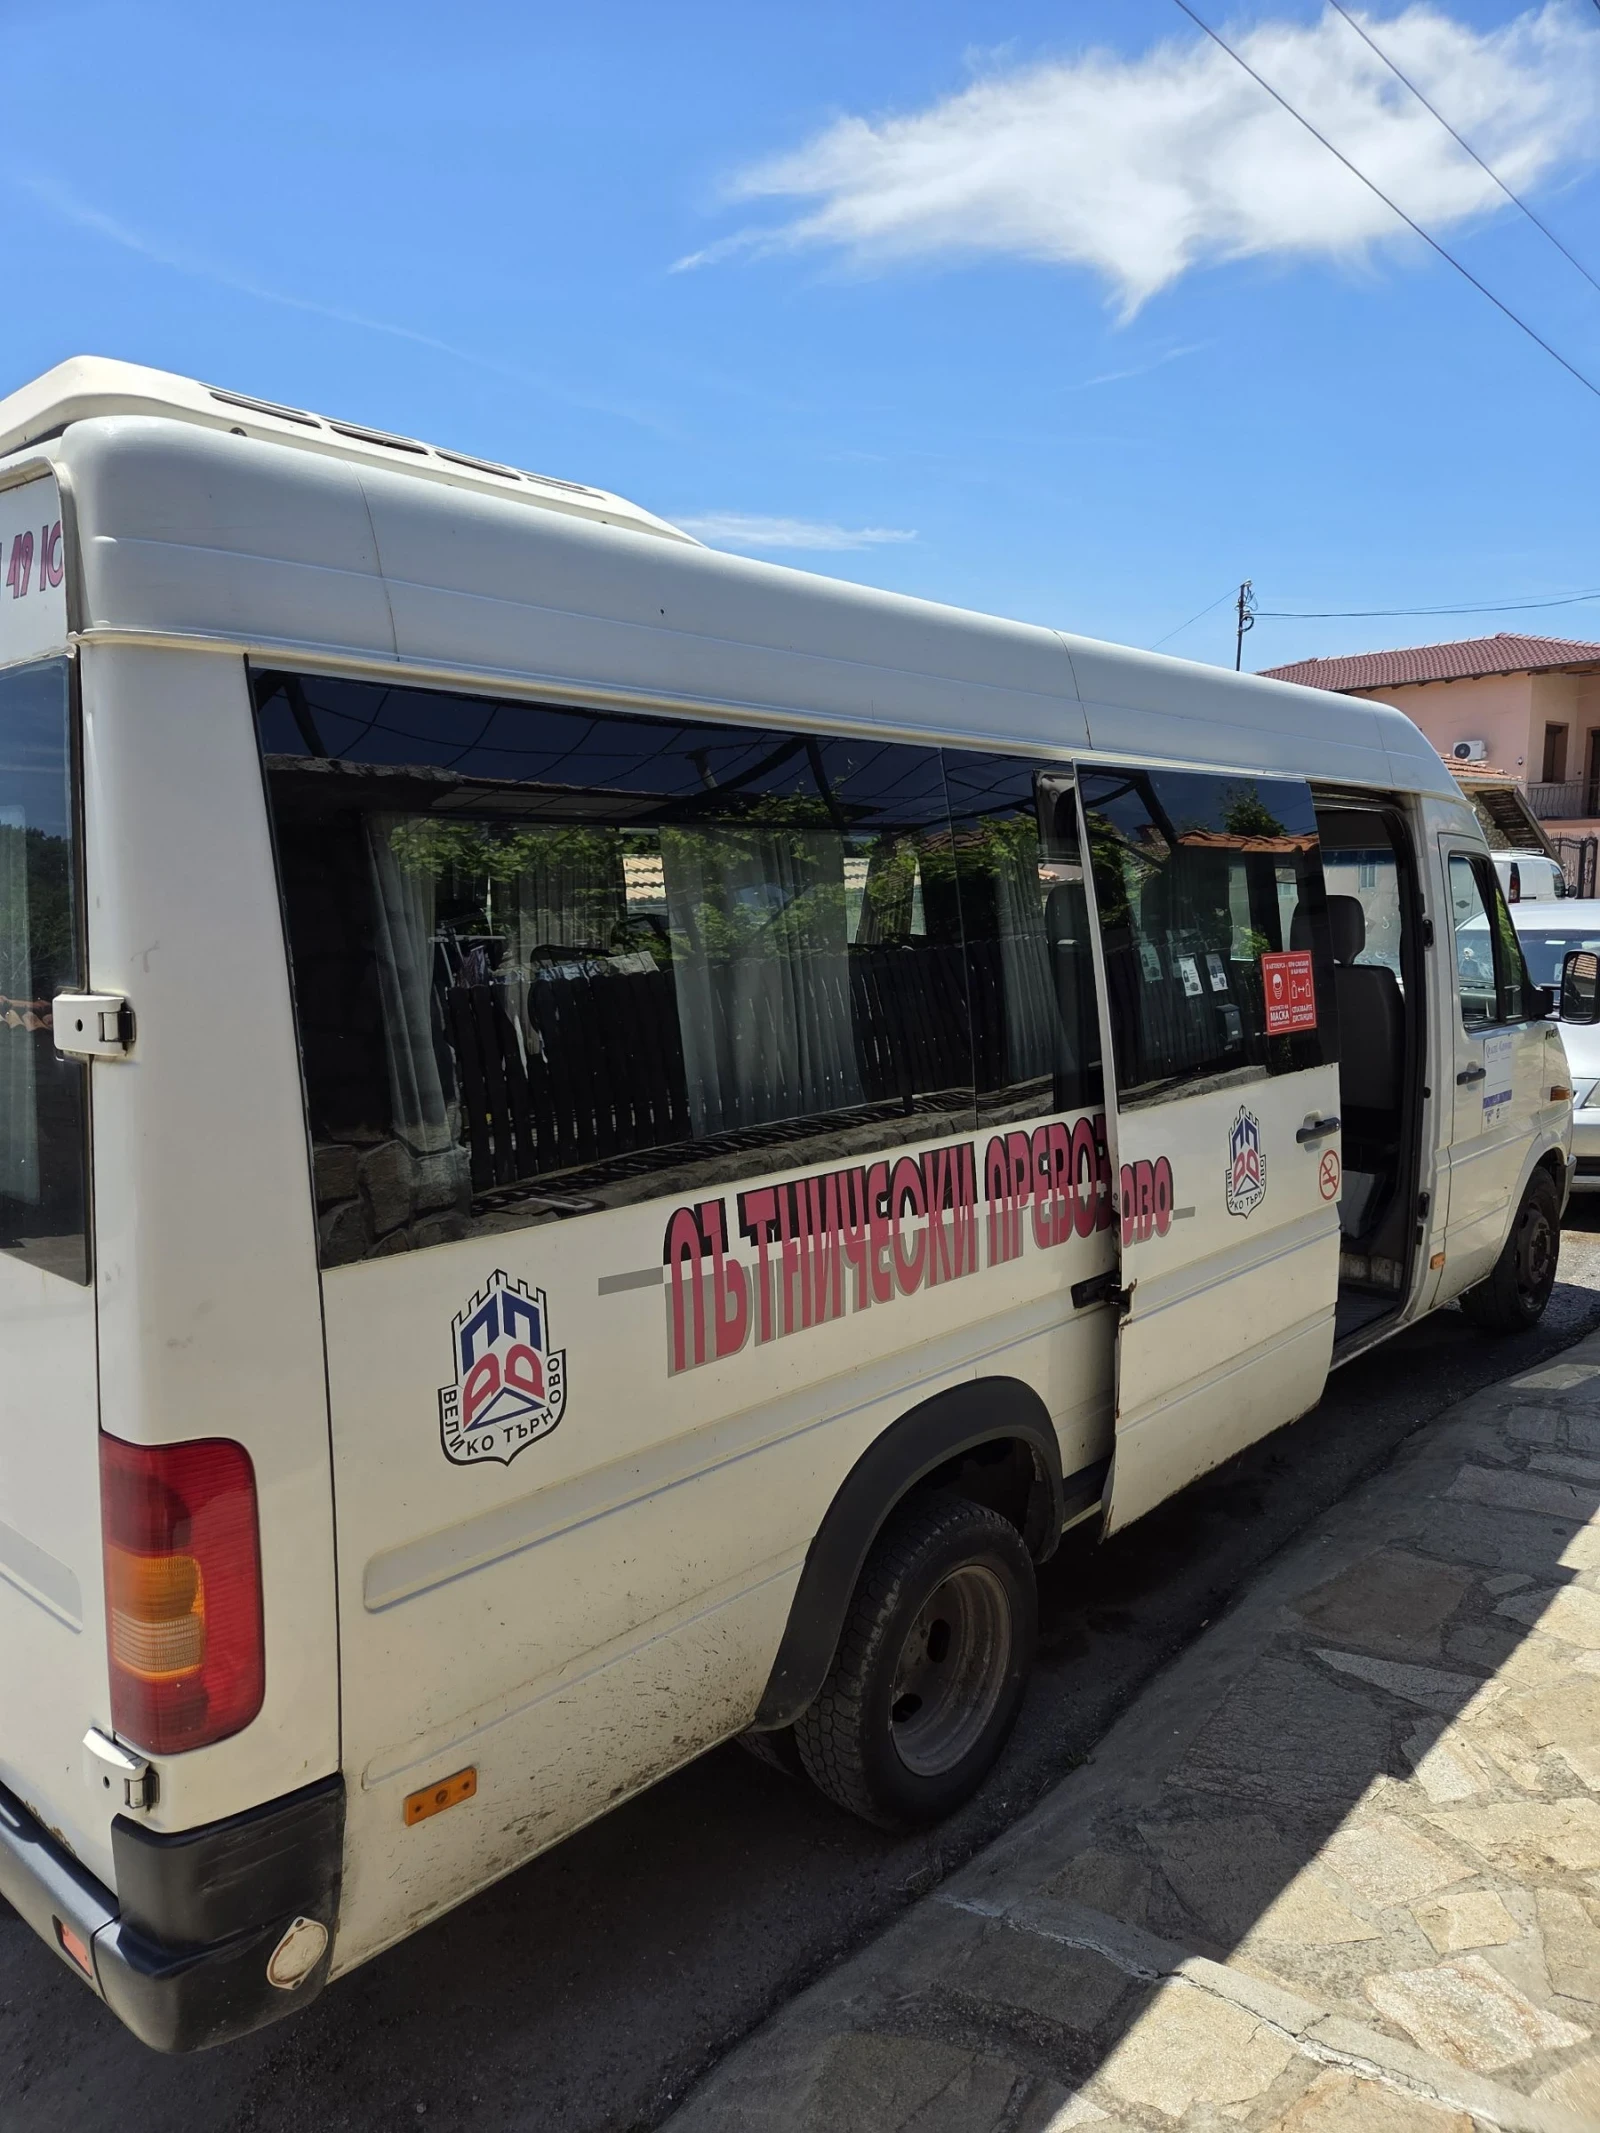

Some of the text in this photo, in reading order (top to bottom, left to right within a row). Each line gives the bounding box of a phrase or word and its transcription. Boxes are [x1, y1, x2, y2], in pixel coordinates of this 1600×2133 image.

[1270, 1010, 1290, 1021] МАСКА
[663, 1141, 979, 1377] ПЪТНИЧЕСКИ
[443, 1357, 562, 1457] ВЕЛИКО ТЪРНОВО
